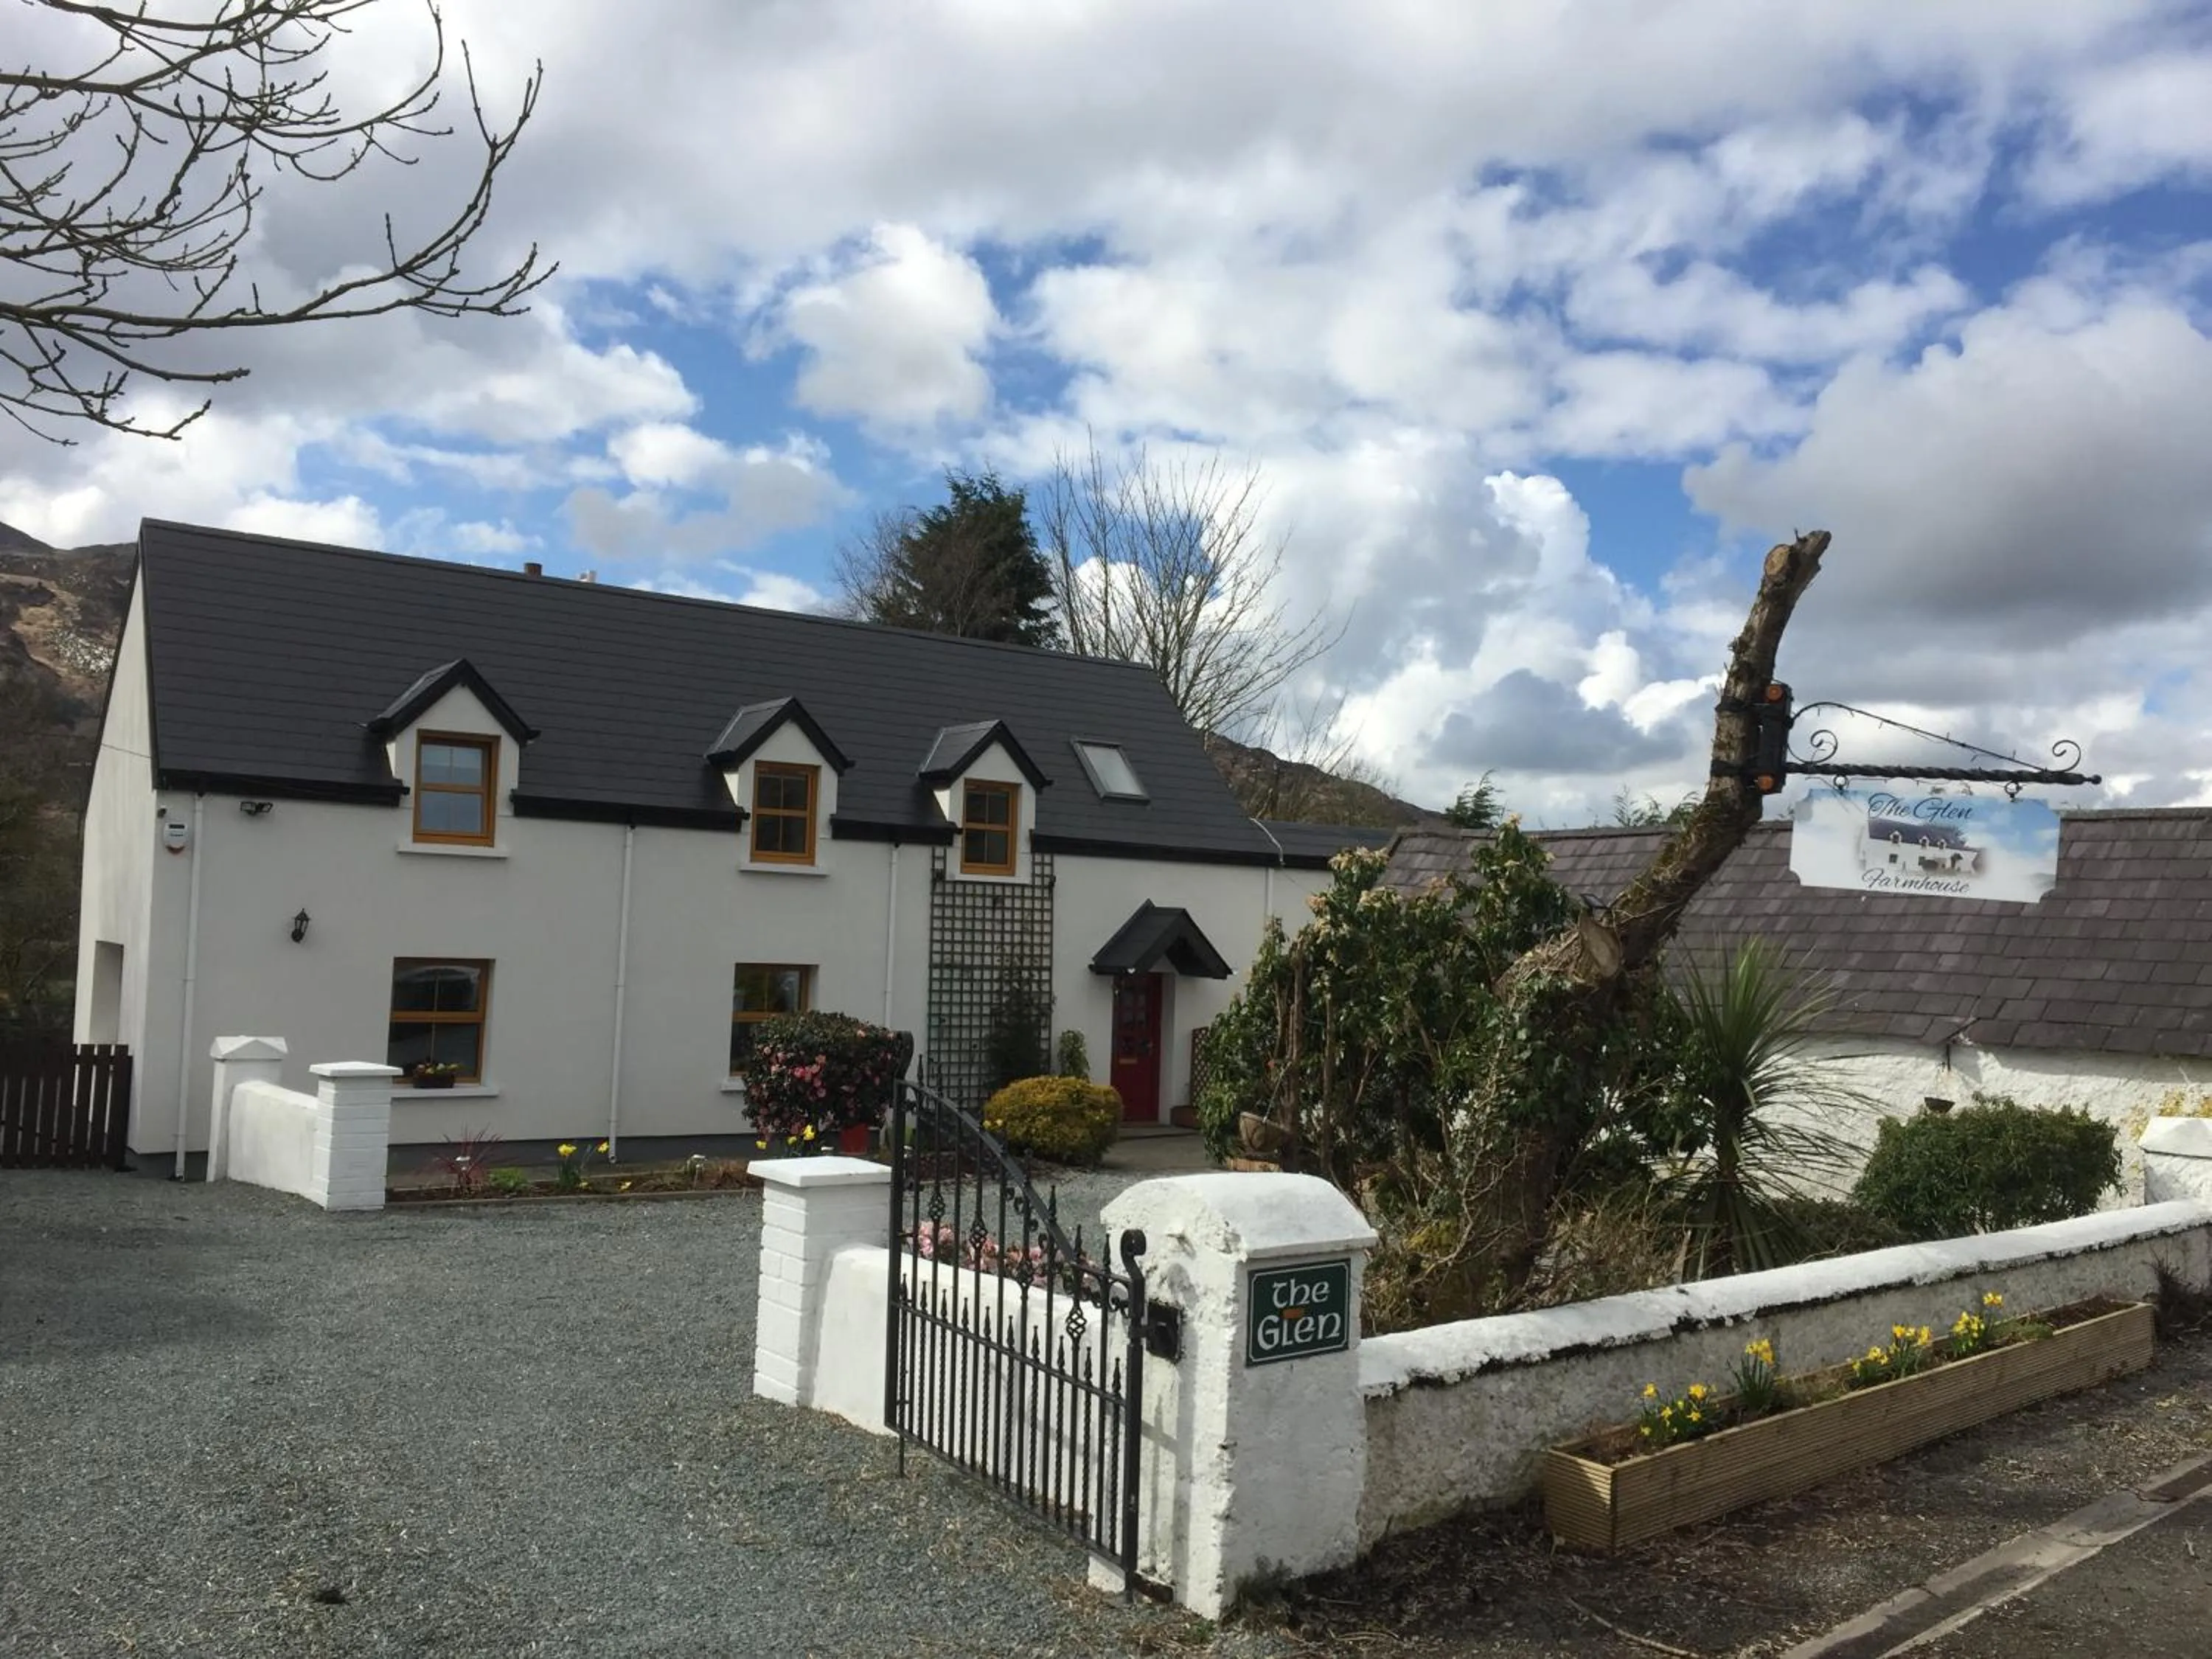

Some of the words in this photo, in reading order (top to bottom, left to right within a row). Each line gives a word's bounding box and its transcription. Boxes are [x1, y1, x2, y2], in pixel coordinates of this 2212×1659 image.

[1868, 793, 1910, 817] The
[1913, 797, 1973, 822] Glen
[1862, 868, 1970, 893] Farmhouse
